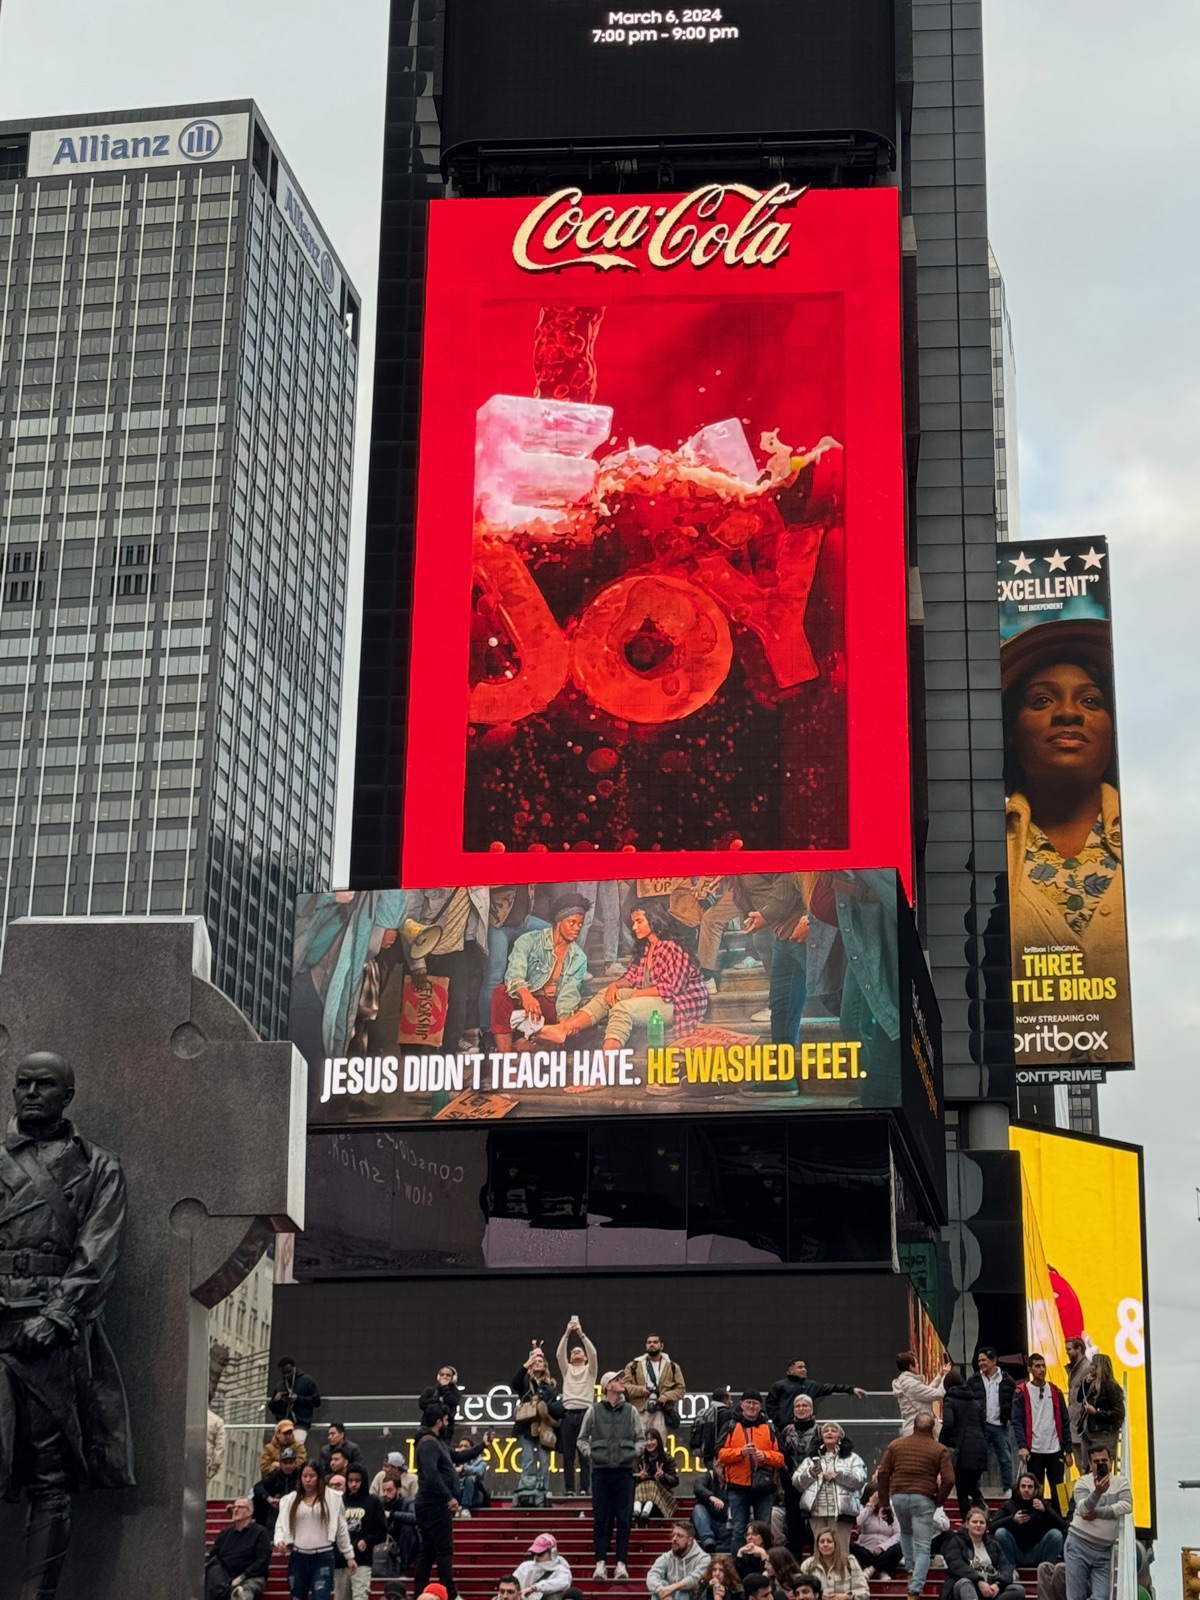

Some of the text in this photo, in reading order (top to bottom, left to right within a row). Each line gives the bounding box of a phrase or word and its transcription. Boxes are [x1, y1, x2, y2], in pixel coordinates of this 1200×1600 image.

[609, 8, 723, 25] March 6, 2024
[592, 29, 626, 43] 7:00
[628, 29, 658, 46] pm
[672, 26, 706, 40] 9:00
[709, 26, 739, 43] pm
[52, 134, 170, 165] Allianz
[284, 185, 320, 269] Allianz
[512, 182, 809, 270] Coca-Cola
[1022, 953, 1084, 977] THREE
[1059, 977, 1117, 1001] BIRDS
[1016, 1013, 1100, 1024] NOW STREAMING ON
[320, 1041, 868, 1104] JESUS DIDN'T TEACH HATE. HE WASHED FEET.
[1016, 1069, 1102, 1083] ONTPRIME
